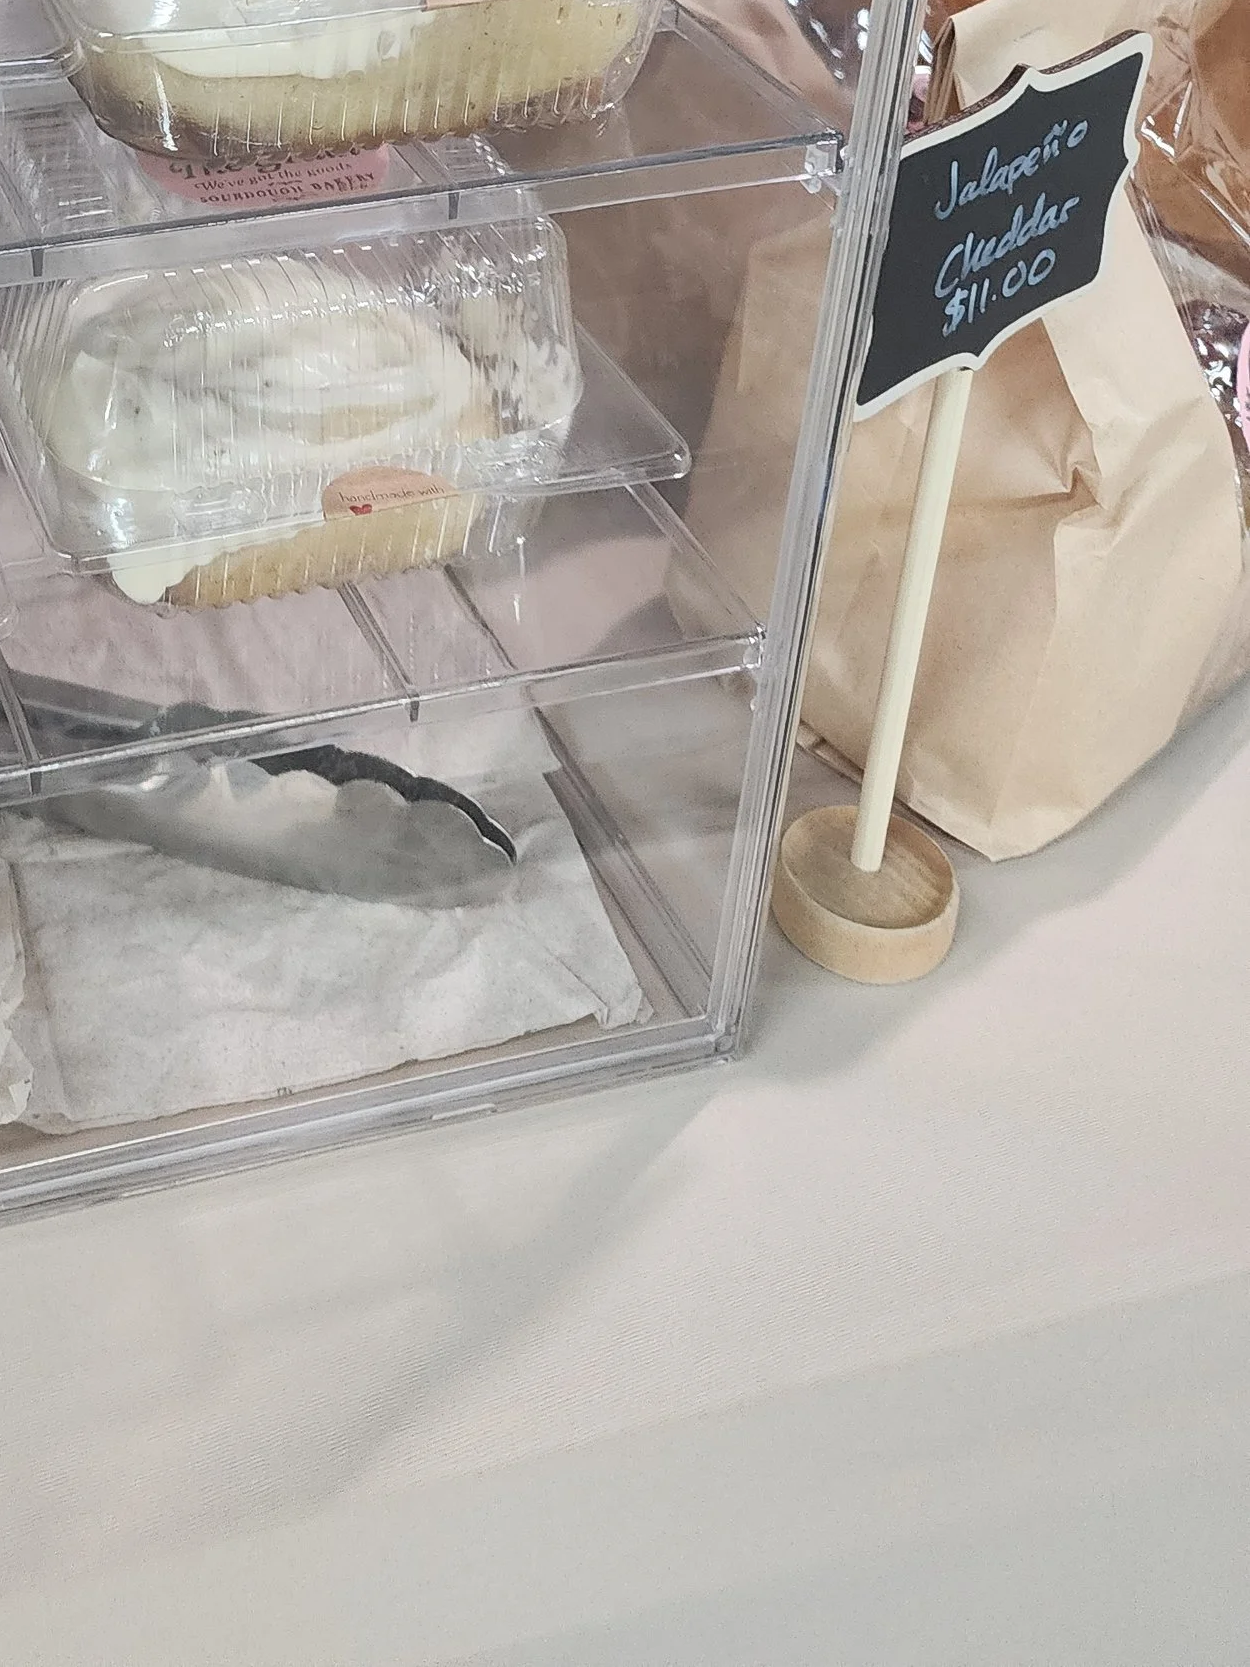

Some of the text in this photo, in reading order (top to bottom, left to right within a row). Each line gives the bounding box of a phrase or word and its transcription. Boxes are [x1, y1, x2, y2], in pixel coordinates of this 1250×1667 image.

[200, 171, 376, 204] SOURDOUGH BAKERY
[933, 119, 1089, 221] Jalapeño
[934, 193, 1080, 298] Cheddar
[942, 248, 1057, 338] $11.00
[338, 484, 446, 504] handmade with
